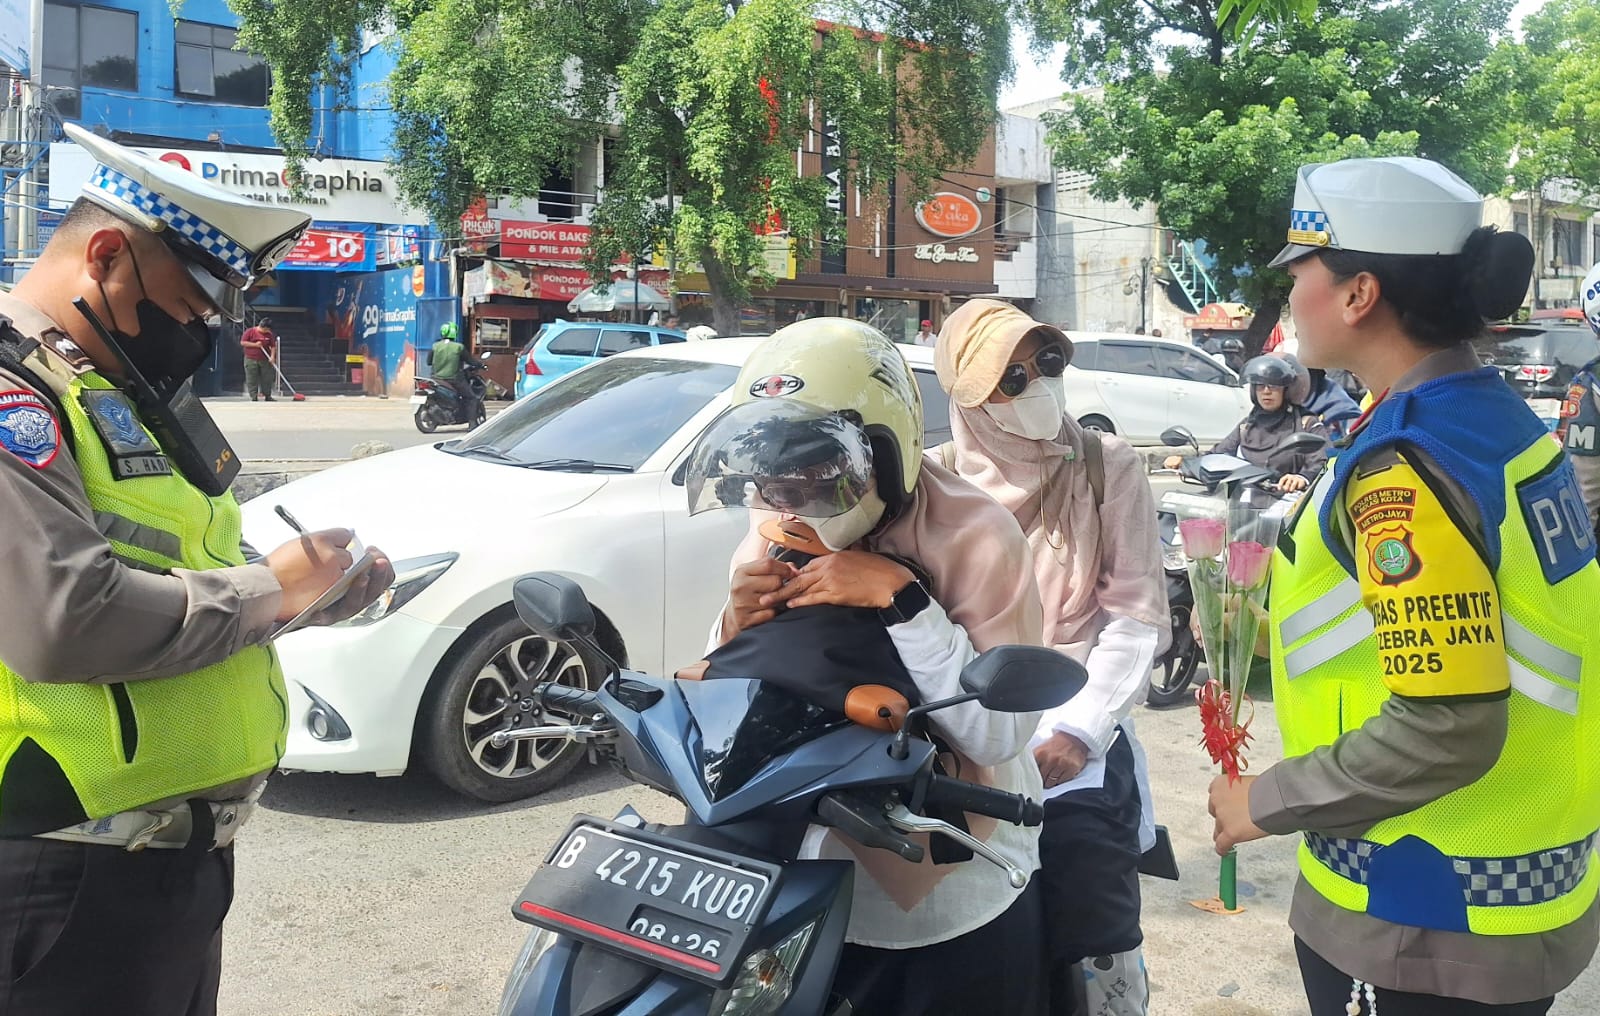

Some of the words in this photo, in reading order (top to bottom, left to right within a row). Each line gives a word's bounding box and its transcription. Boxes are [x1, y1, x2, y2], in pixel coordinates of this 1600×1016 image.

[506, 227, 557, 241] PONDOK
[528, 244, 536, 253] &
[539, 245, 559, 254] MIE
[543, 274, 581, 285] PONDOK
[1353, 492, 1378, 512] POLRES
[1379, 489, 1411, 499] METRO
[1404, 591, 1491, 623] PREEMTIF
[1378, 628, 1434, 651] ZEBRA
[1445, 624, 1495, 646] JAYA
[1384, 652, 1443, 675] 2025
[557, 835, 587, 869] B
[595, 848, 681, 897] 4215
